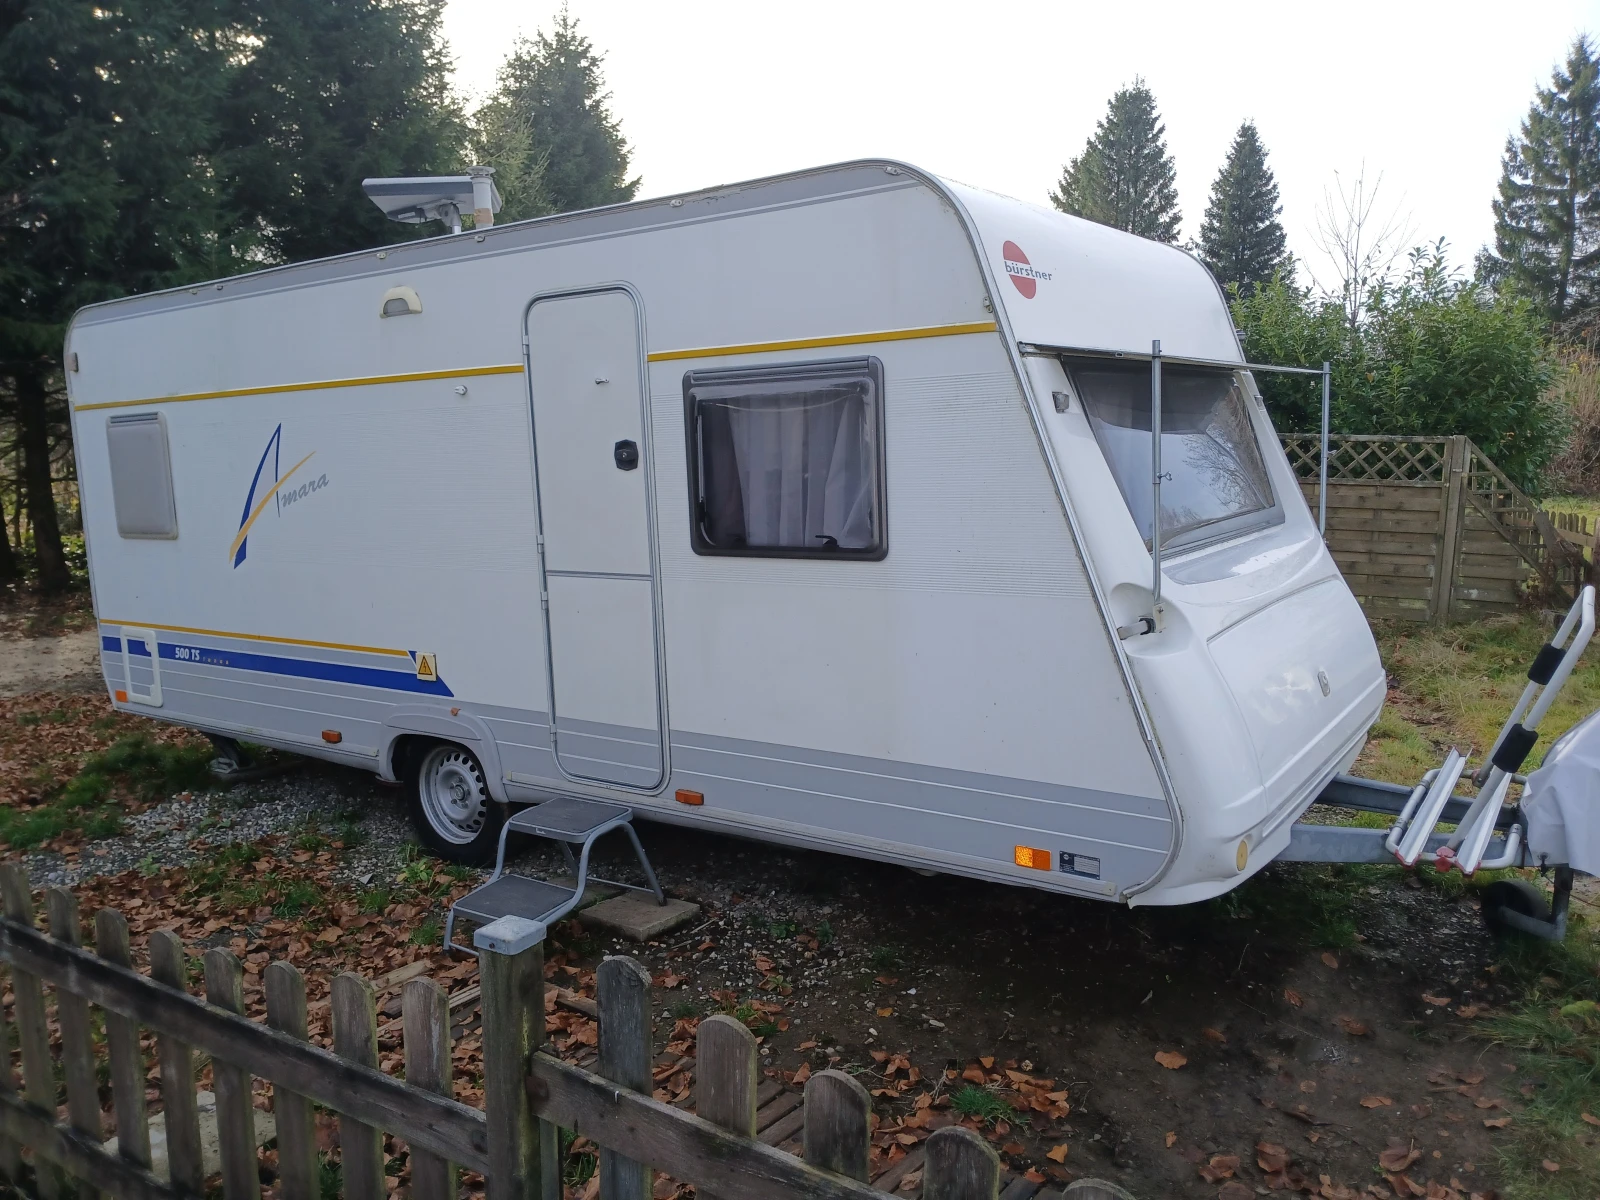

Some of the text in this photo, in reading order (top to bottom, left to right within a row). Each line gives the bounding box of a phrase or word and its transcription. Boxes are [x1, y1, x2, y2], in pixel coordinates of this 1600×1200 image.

[1004, 260, 1053, 281] bürstner
[229, 422, 330, 570] Amara
[175, 646, 190, 660] 500
[191, 649, 200, 661] TS
